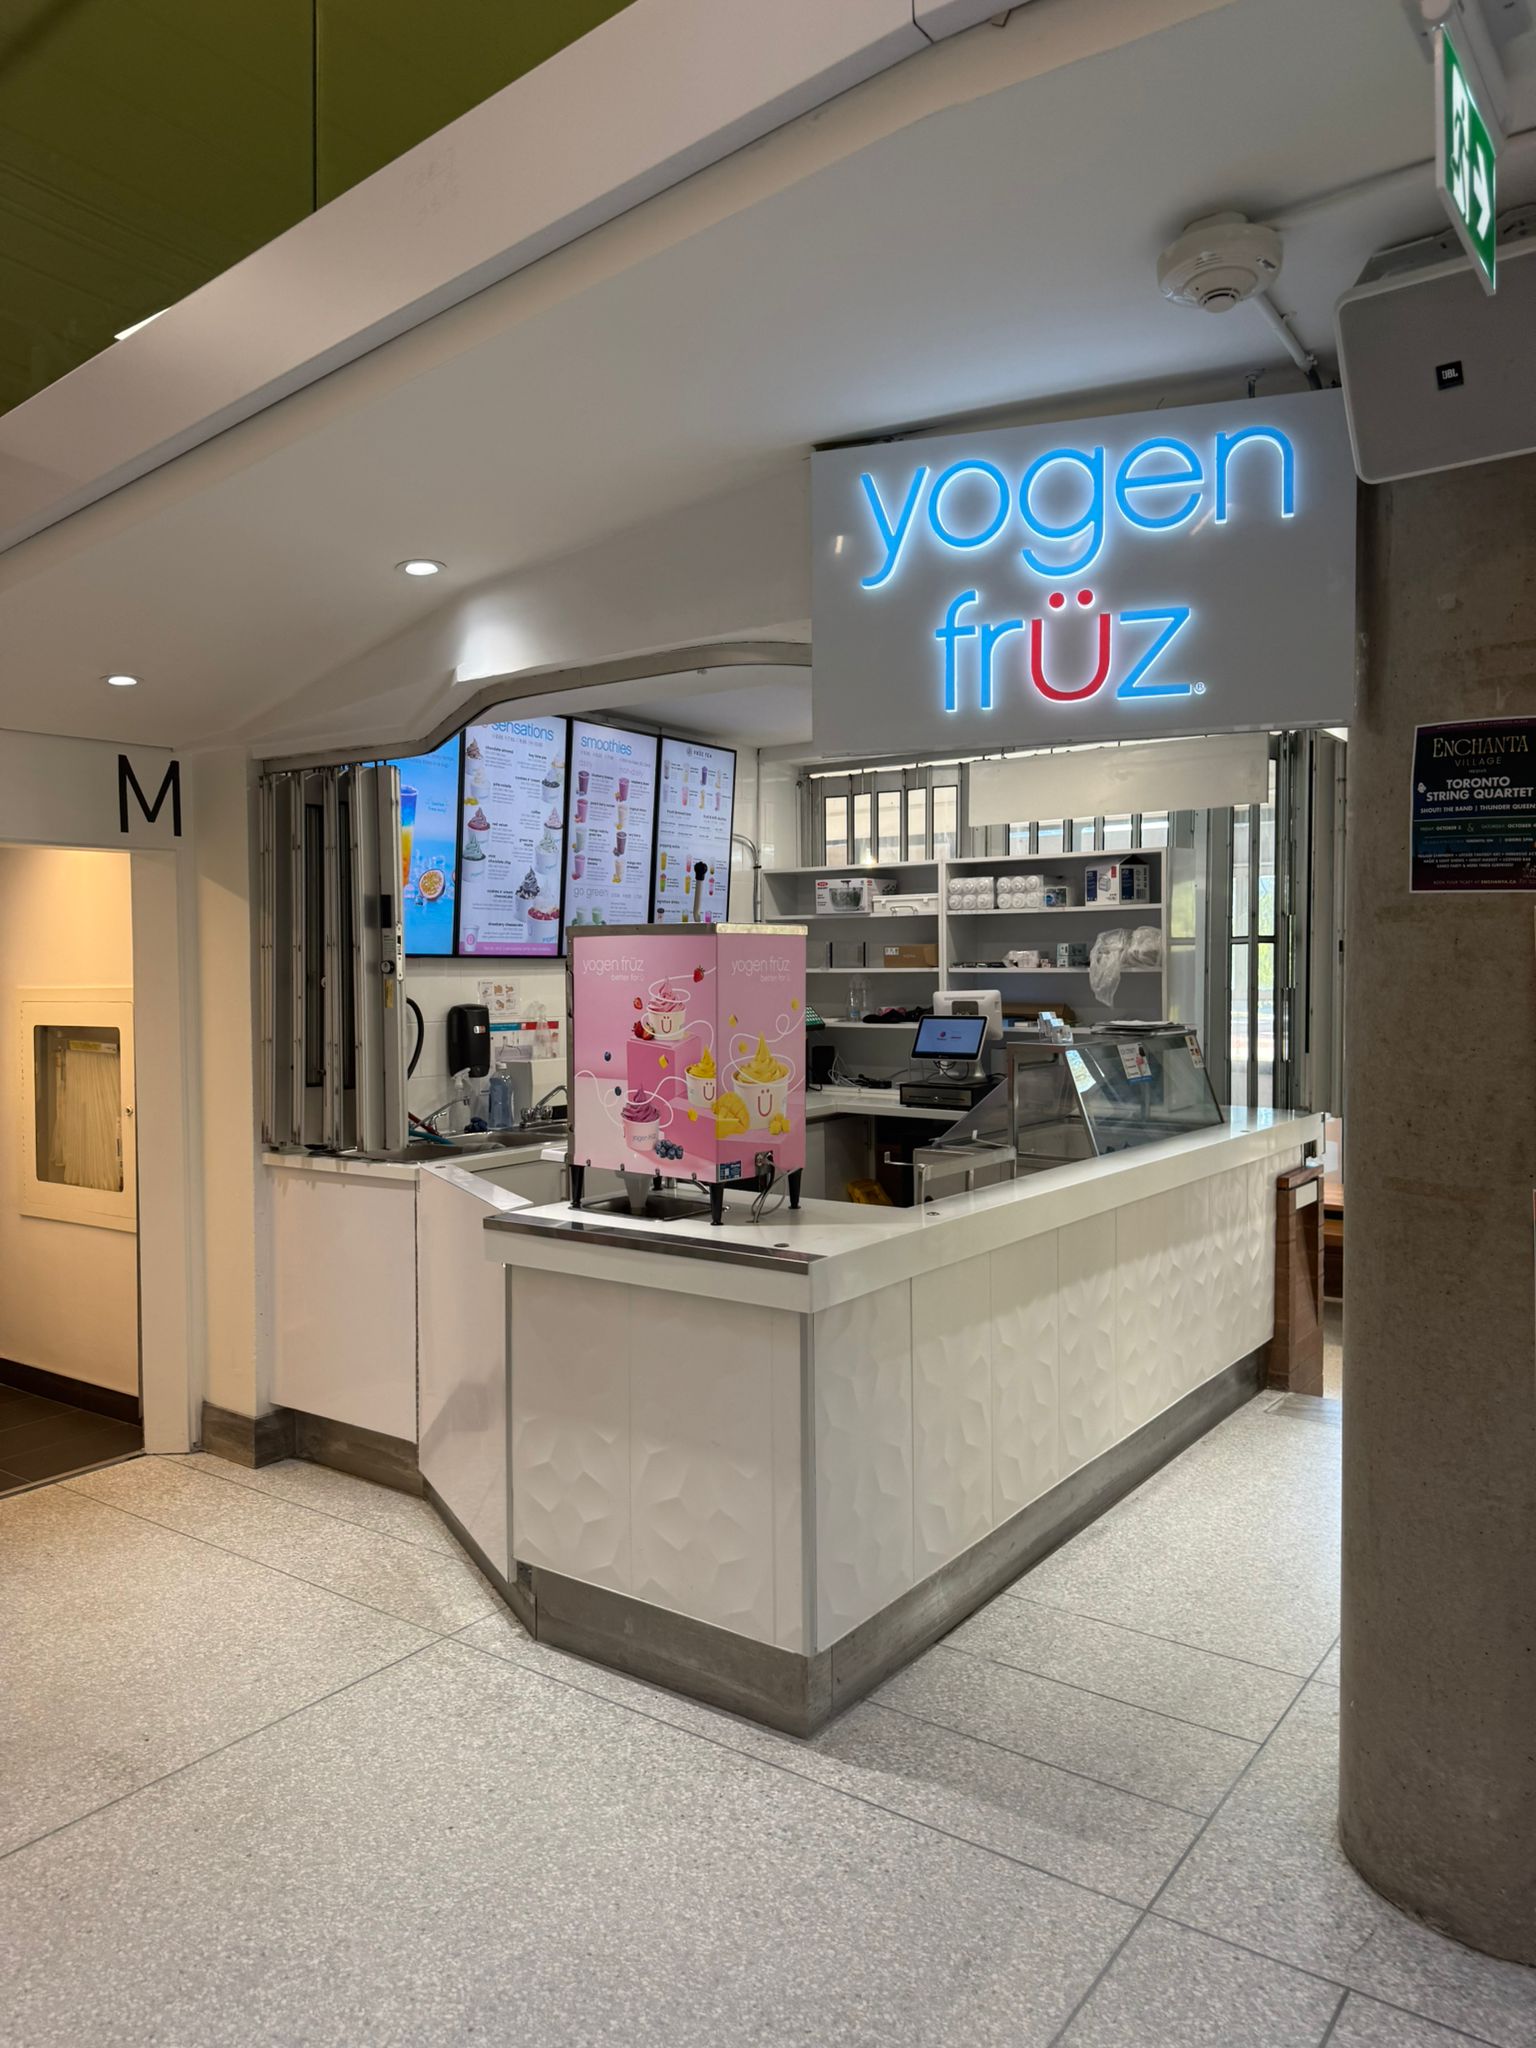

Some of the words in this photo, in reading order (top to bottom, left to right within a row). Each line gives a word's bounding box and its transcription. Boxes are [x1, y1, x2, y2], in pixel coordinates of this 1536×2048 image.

[1442, 368, 1458, 380] JBL
[860, 425, 1295, 590] yogen
[935, 588, 1194, 713] früz
[490, 721, 554, 742] sensations
[580, 736, 632, 756] smoothies
[1454, 756, 1503, 767] VILLAGE
[1446, 776, 1511, 789] TORONTO
[117, 754, 182, 837] M
[1426, 789, 1470, 802] STRING
[1473, 787, 1534, 799] QUARTET
[582, 959, 619, 976] yogen
[730, 959, 768, 977] yogen
